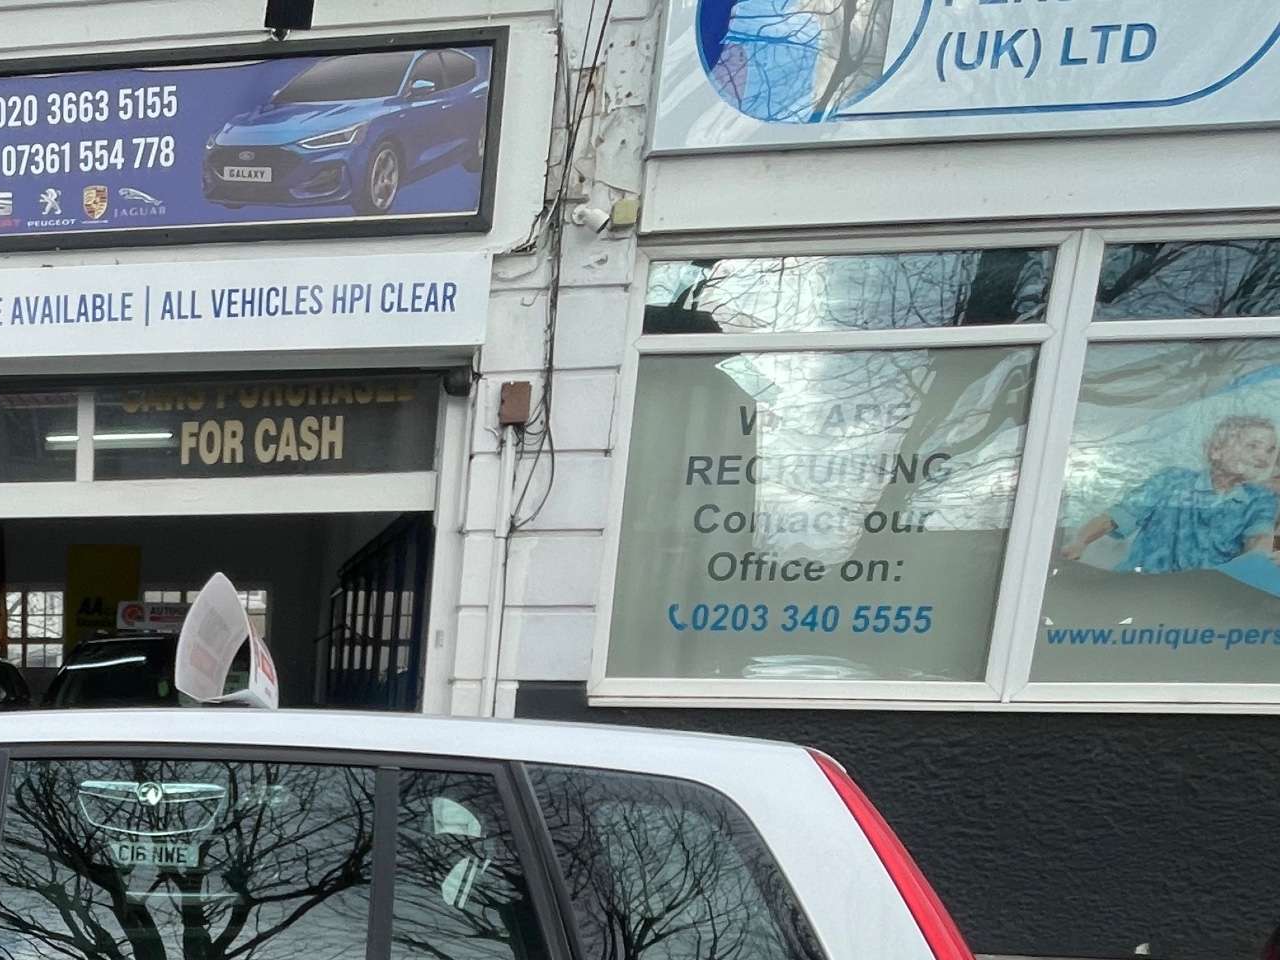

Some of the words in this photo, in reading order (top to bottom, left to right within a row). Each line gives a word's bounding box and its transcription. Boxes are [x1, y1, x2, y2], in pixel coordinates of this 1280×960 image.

[936, 28, 1042, 82] (UK)
[1060, 23, 1157, 66] LTD
[47, 91, 110, 125] 3663
[119, 86, 178, 120] 5155
[2, 143, 72, 177] 07361
[79, 138, 125, 171] 554
[132, 136, 176, 168] 778
[27, 218, 77, 228] PEUGEOT
[114, 207, 167, 218] JAGUAR
[11, 292, 134, 326] AVAILABLE
[161, 290, 203, 321] ALL
[211, 285, 324, 318] VEHICLES
[331, 284, 372, 315] HPI
[380, 282, 458, 313] CLEAR
[180, 419, 245, 465] FOR
[254, 415, 344, 463] CASH
[864, 510, 936, 534] our
[707, 551, 826, 582] Office
[840, 559, 905, 582] on:
[691, 603, 768, 633] 0203
[782, 603, 840, 633] 340
[852, 604, 934, 635] 5555
